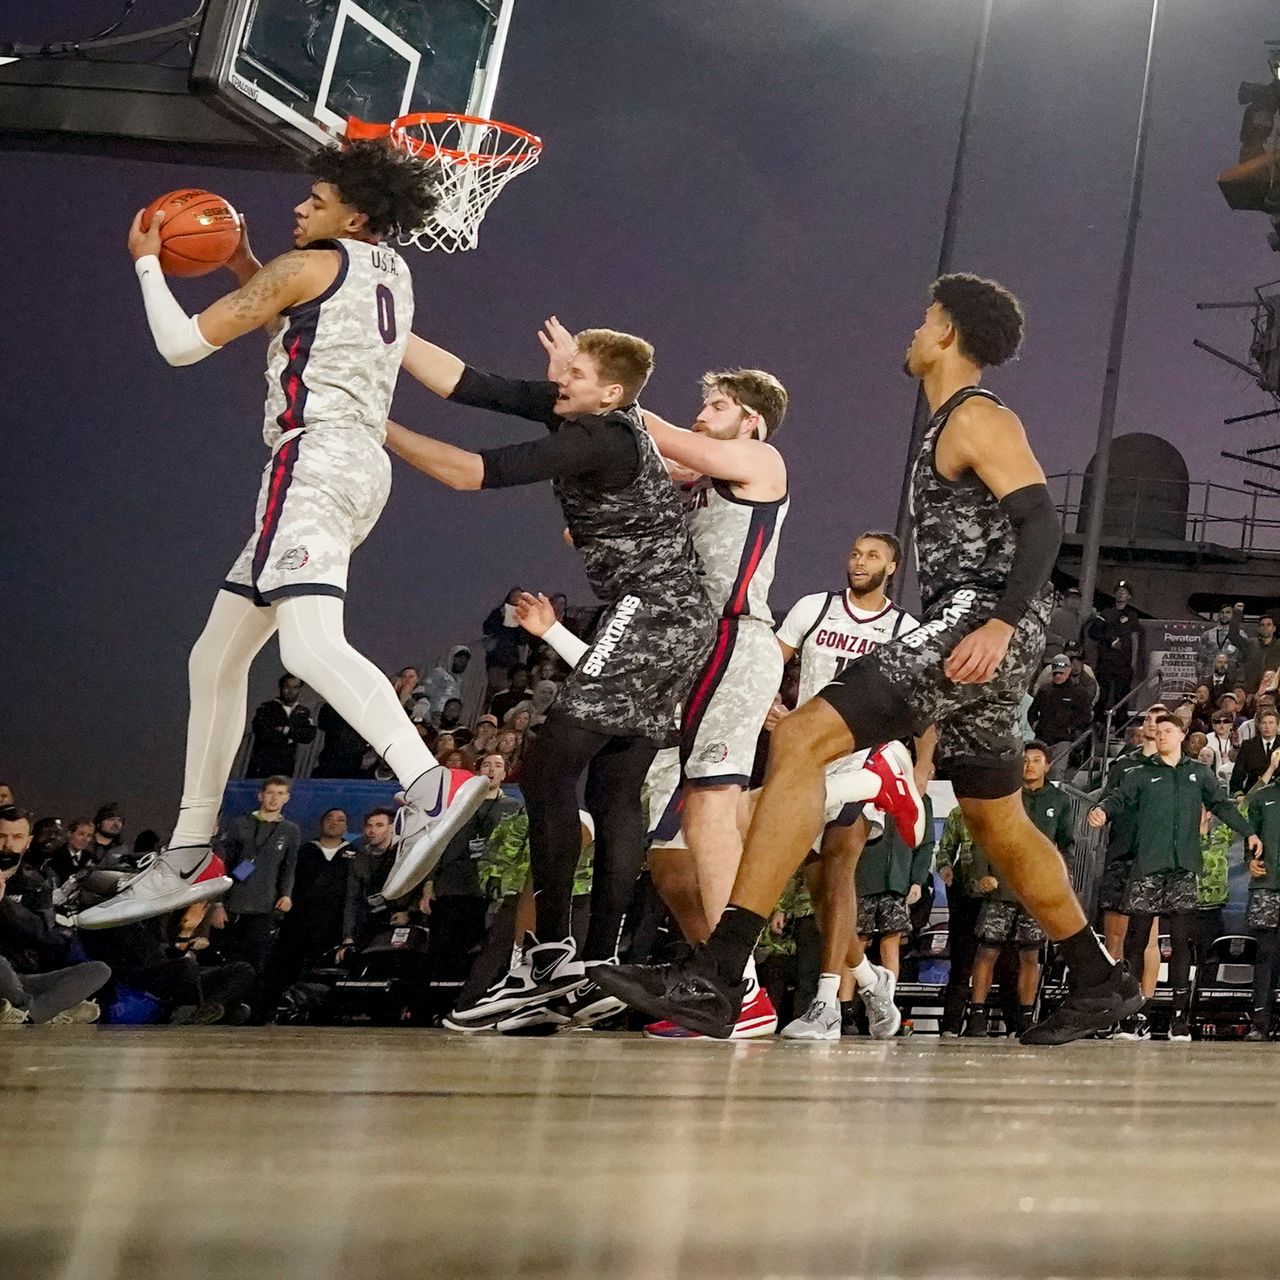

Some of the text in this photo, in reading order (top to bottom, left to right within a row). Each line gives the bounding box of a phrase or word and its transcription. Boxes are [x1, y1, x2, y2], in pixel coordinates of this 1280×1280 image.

[376, 283, 397, 344] 0
[582, 594, 641, 677] SPARTANS
[816, 629, 878, 656] GONZA
